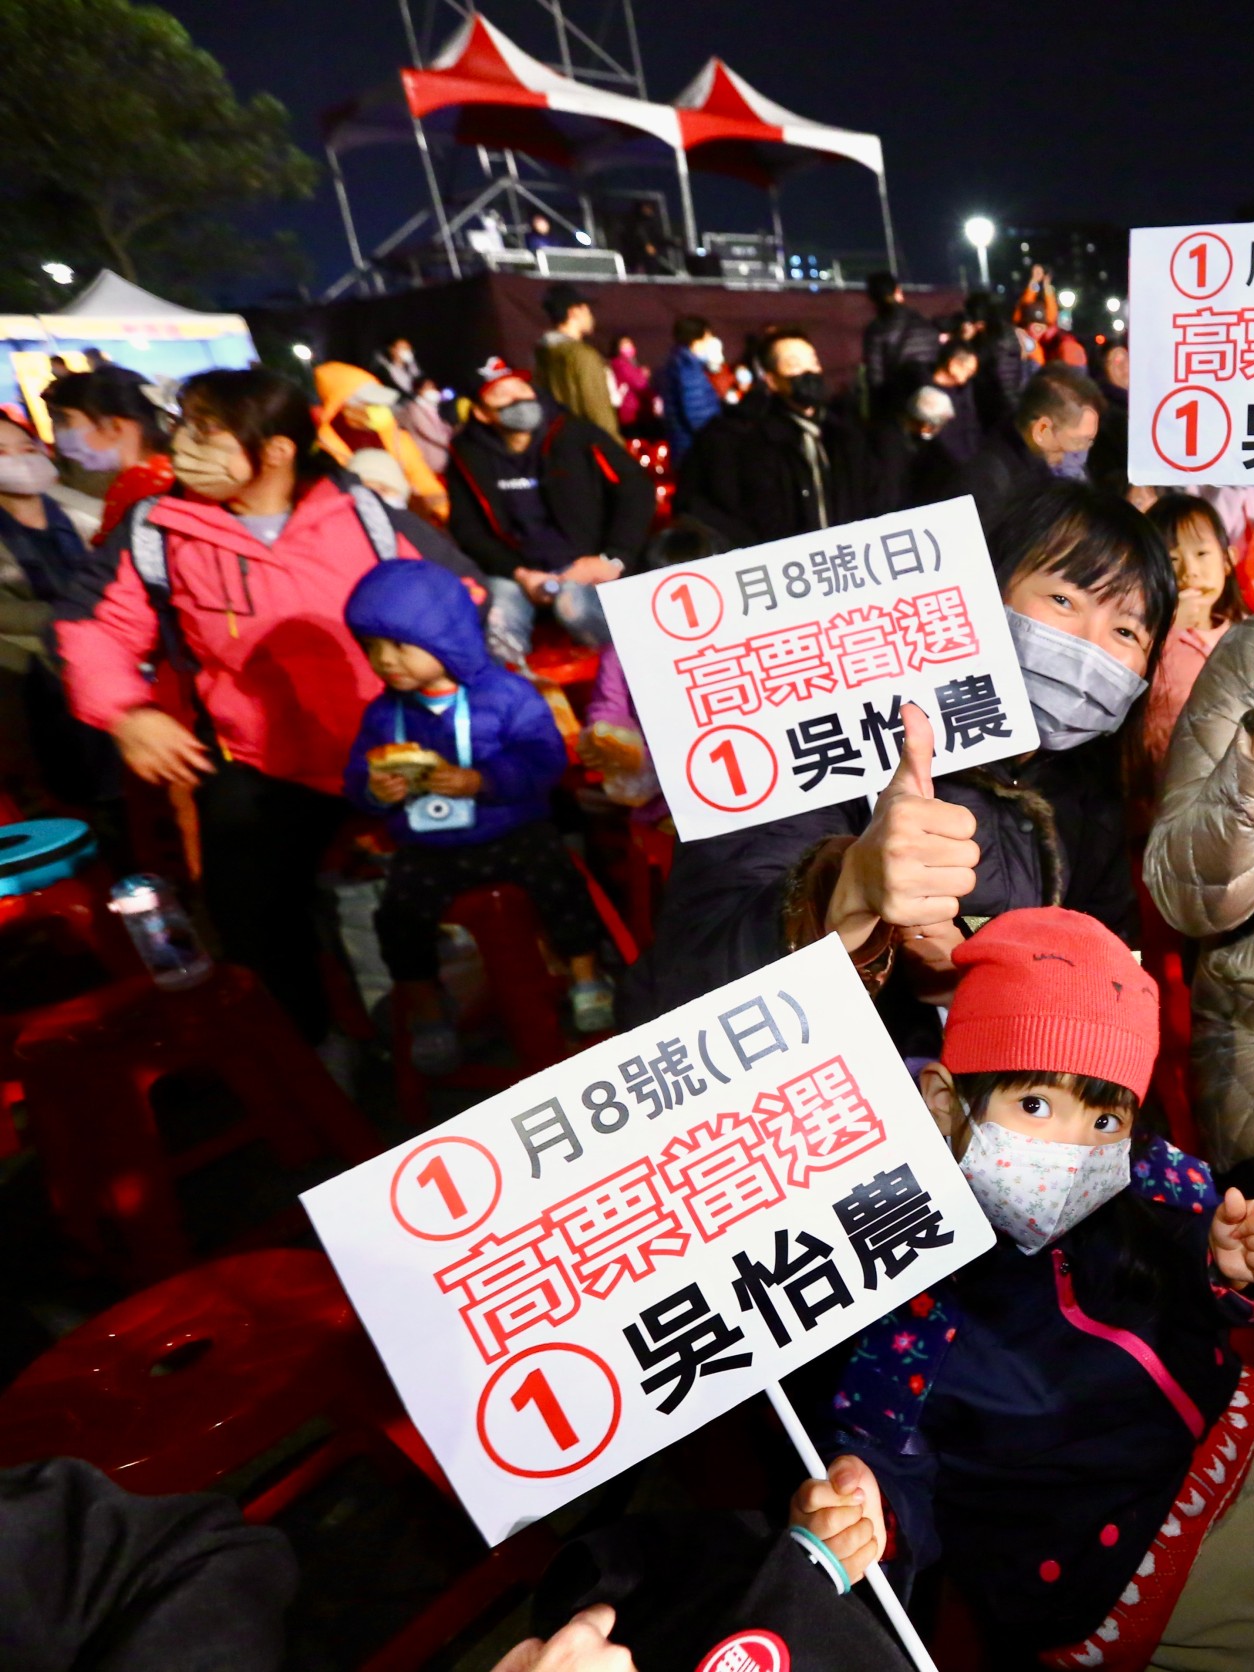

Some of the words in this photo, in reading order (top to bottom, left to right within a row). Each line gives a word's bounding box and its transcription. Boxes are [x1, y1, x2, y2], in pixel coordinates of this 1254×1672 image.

[673, 585, 980, 729] 高票當選
[433, 1055, 887, 1366] 高票當選
